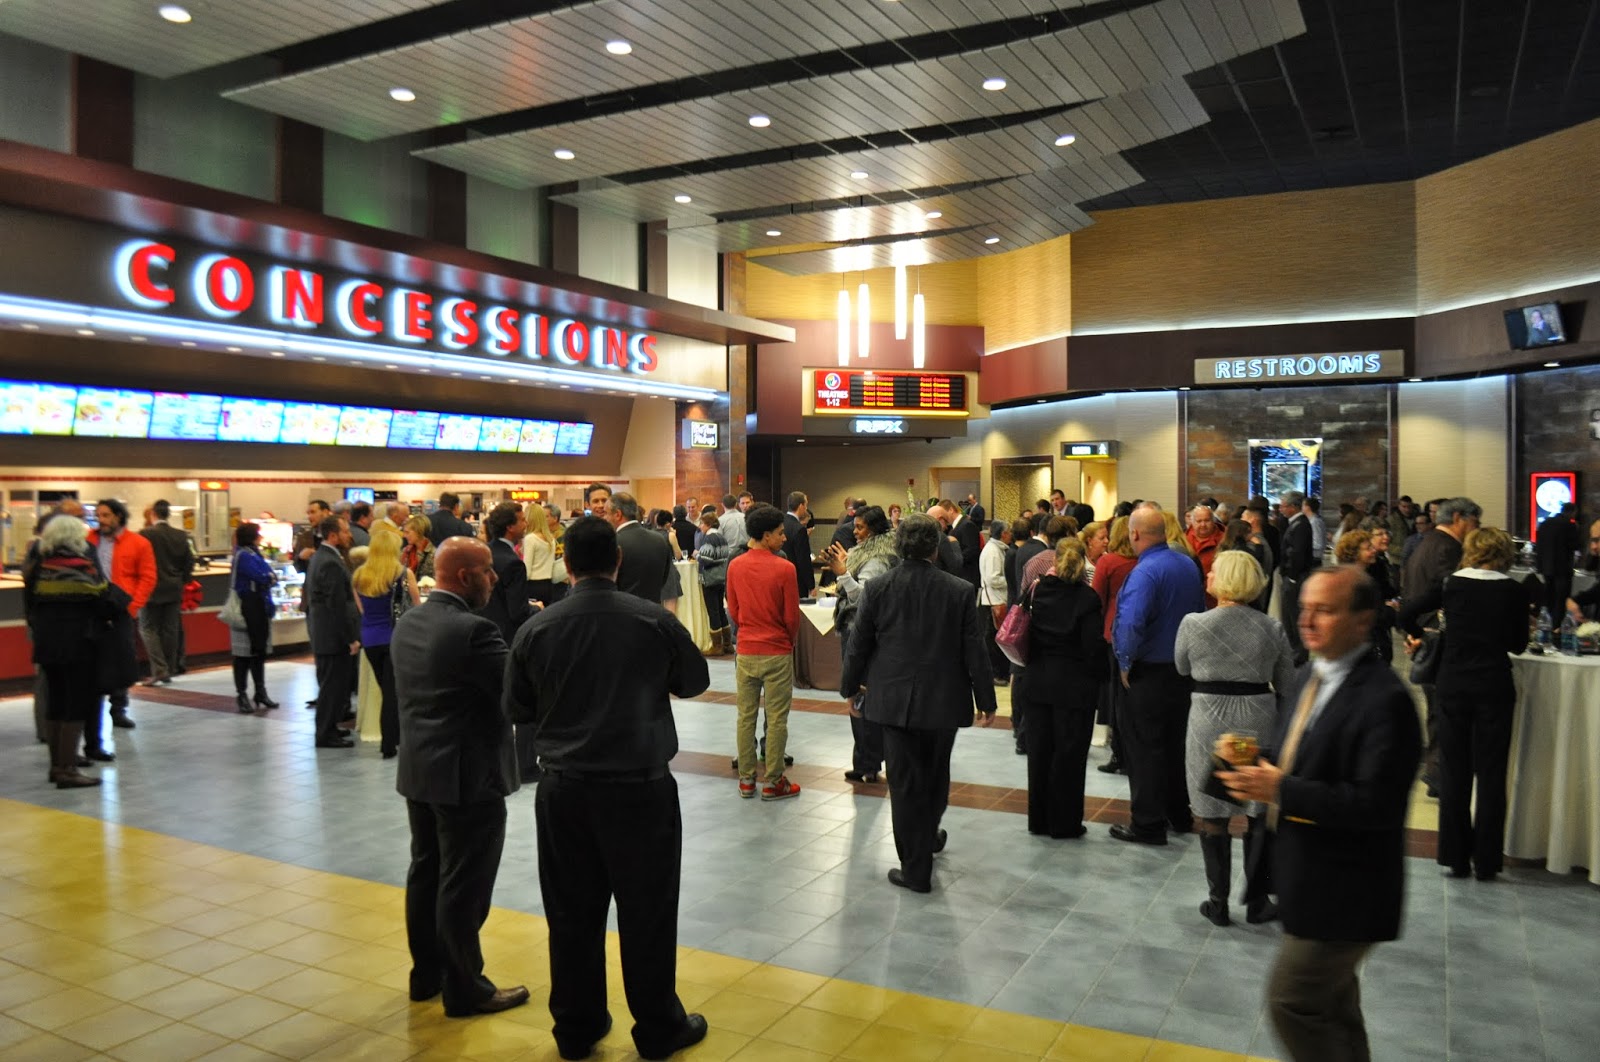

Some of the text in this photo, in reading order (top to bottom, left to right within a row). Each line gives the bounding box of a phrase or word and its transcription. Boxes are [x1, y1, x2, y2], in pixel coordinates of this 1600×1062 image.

[115, 239, 658, 374] CONCESSIONS
[1215, 353, 1381, 379] RESTROOMS
[856, 420, 903, 433] RPX
